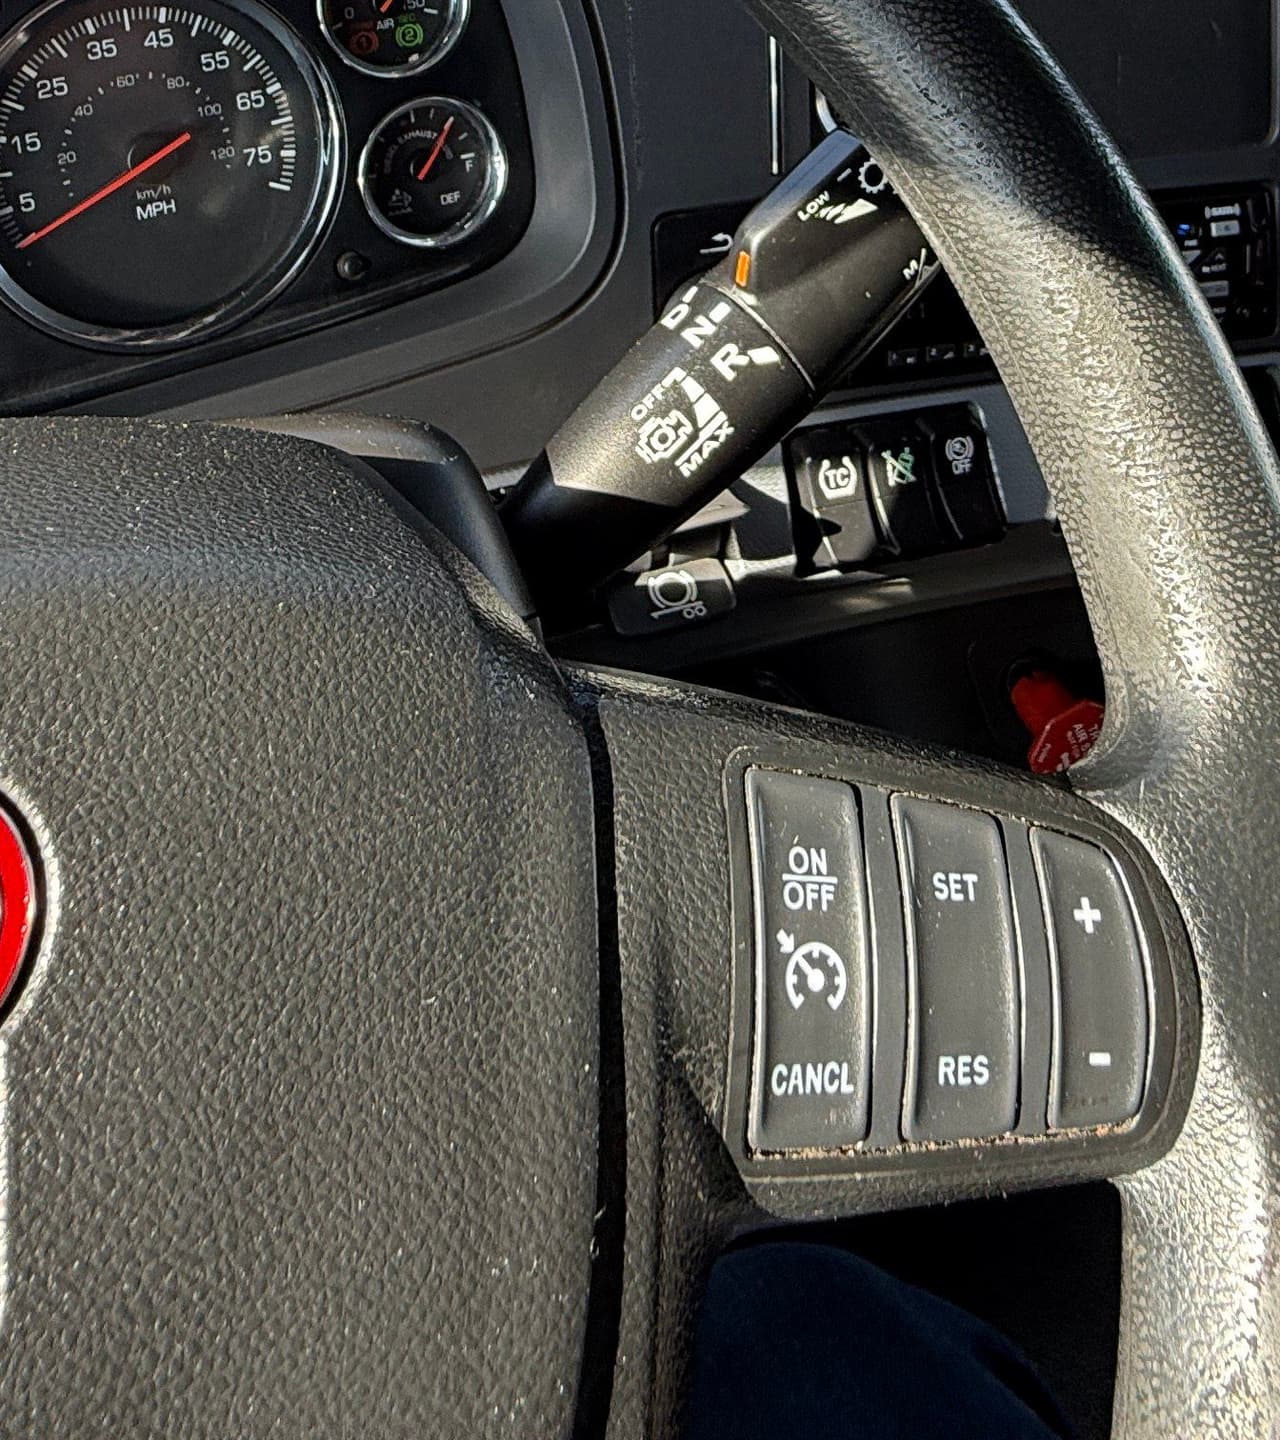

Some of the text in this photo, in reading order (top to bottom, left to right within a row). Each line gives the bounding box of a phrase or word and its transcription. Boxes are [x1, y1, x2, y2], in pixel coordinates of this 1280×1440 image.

[344, 7, 355, 20] 0
[376, 18, 395, 30] AIR
[86, 38, 118, 61] 35
[143, 28, 175, 49] 45
[201, 51, 231, 73] 55
[36, 76, 69, 100] 25
[116, 74, 136, 89] 60
[166, 76, 186, 90] 80
[74, 103, 95, 118] 40
[197, 103, 223, 117] 100
[235, 89, 266, 111] 65
[10, 131, 42, 155] 15
[210, 146, 236, 161] 120
[57, 151, 78, 166] 20
[242, 146, 274, 167] 75
[465, 160, 474, 173] F
[19, 192, 36, 213] 5
[135, 183, 173, 201] km/h
[440, 190, 461, 206] DEF
[135, 199, 177, 222] MPH
[798, 190, 832, 224] LOW
[660, 303, 690, 331] D
[681, 319, 718, 351] N
[710, 343, 750, 382] R
[629, 379, 669, 422] OFF
[678, 418, 736, 479] MAX
[822, 464, 852, 489] TC
[788, 845, 828, 874] ON
[782, 880, 836, 912] OFF
[932, 872, 979, 902] SET
[770, 1060, 855, 1096] CANCL
[937, 1055, 990, 1086] RES
